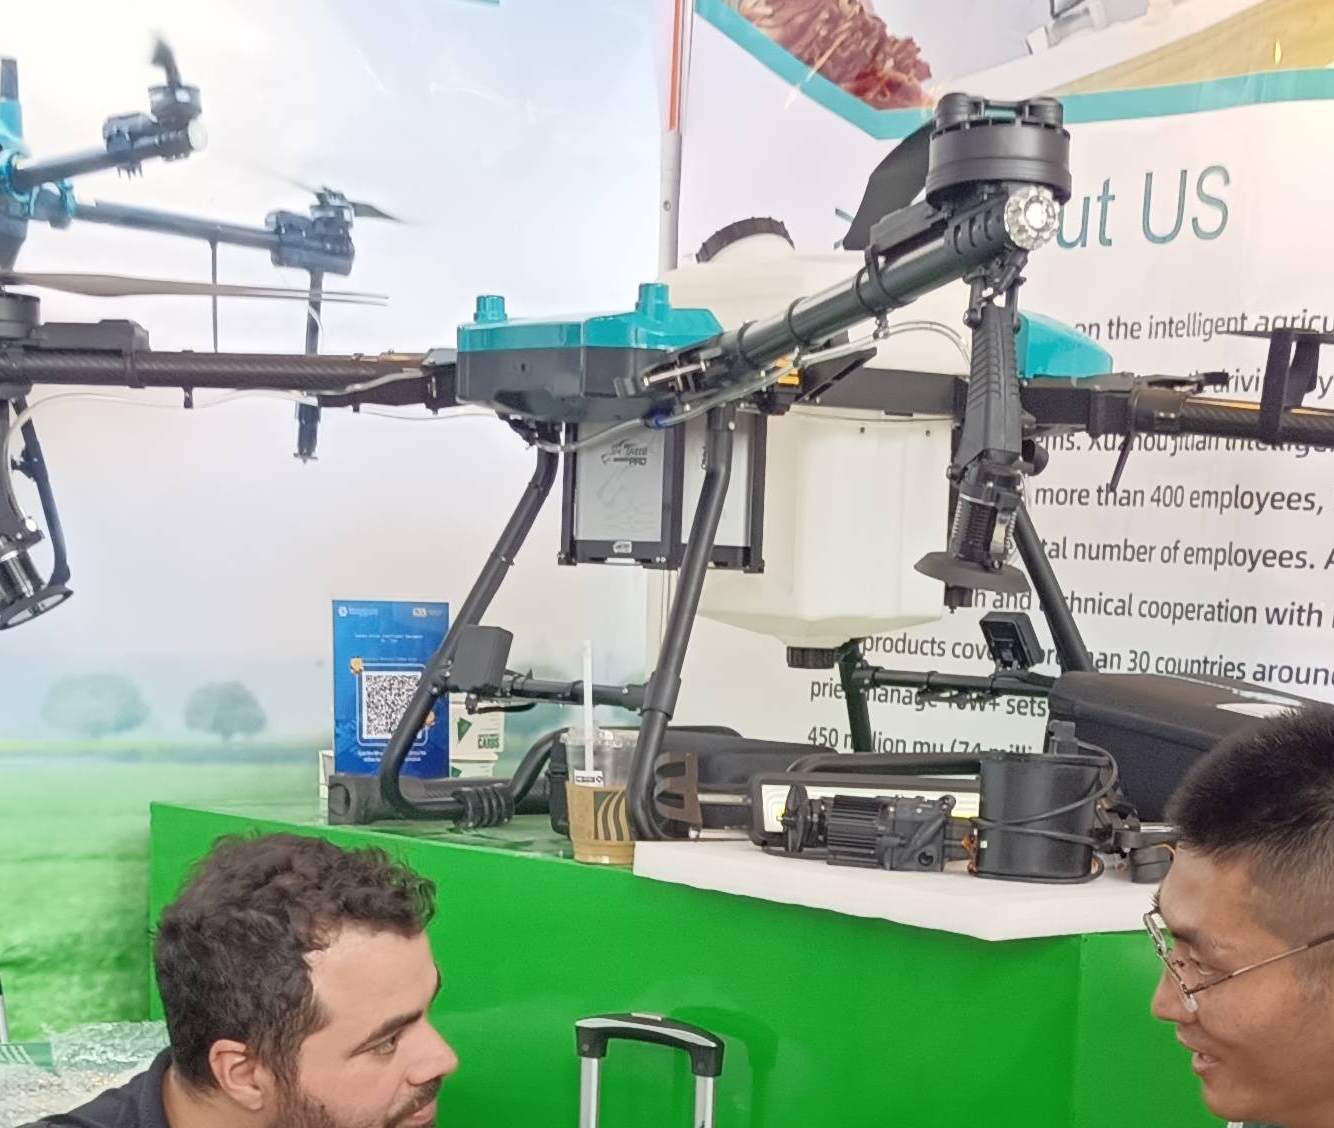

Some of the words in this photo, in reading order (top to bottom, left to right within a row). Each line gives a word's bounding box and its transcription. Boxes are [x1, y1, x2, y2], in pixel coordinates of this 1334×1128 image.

[1141, 164, 1231, 246] US
[1108, 316, 1142, 341] the
[1147, 311, 1248, 343] intelligent
[1034, 485, 1091, 506] more
[1096, 483, 1146, 507] than
[1150, 484, 1185, 508] 400
[1189, 483, 1324, 516] employees,
[1073, 539, 1157, 564] number
[1160, 539, 1181, 565] of
[1183, 540, 1316, 573] employees.
[1137, 592, 1258, 627] cooperation
[1265, 600, 1324, 630] with
[862, 632, 947, 659] products
[1126, 649, 1152, 674] 30
[1154, 652, 1247, 682] countries
[809, 678, 845, 701] prie
[1004, 694, 1048, 718] sets
[807, 726, 840, 749] 450
